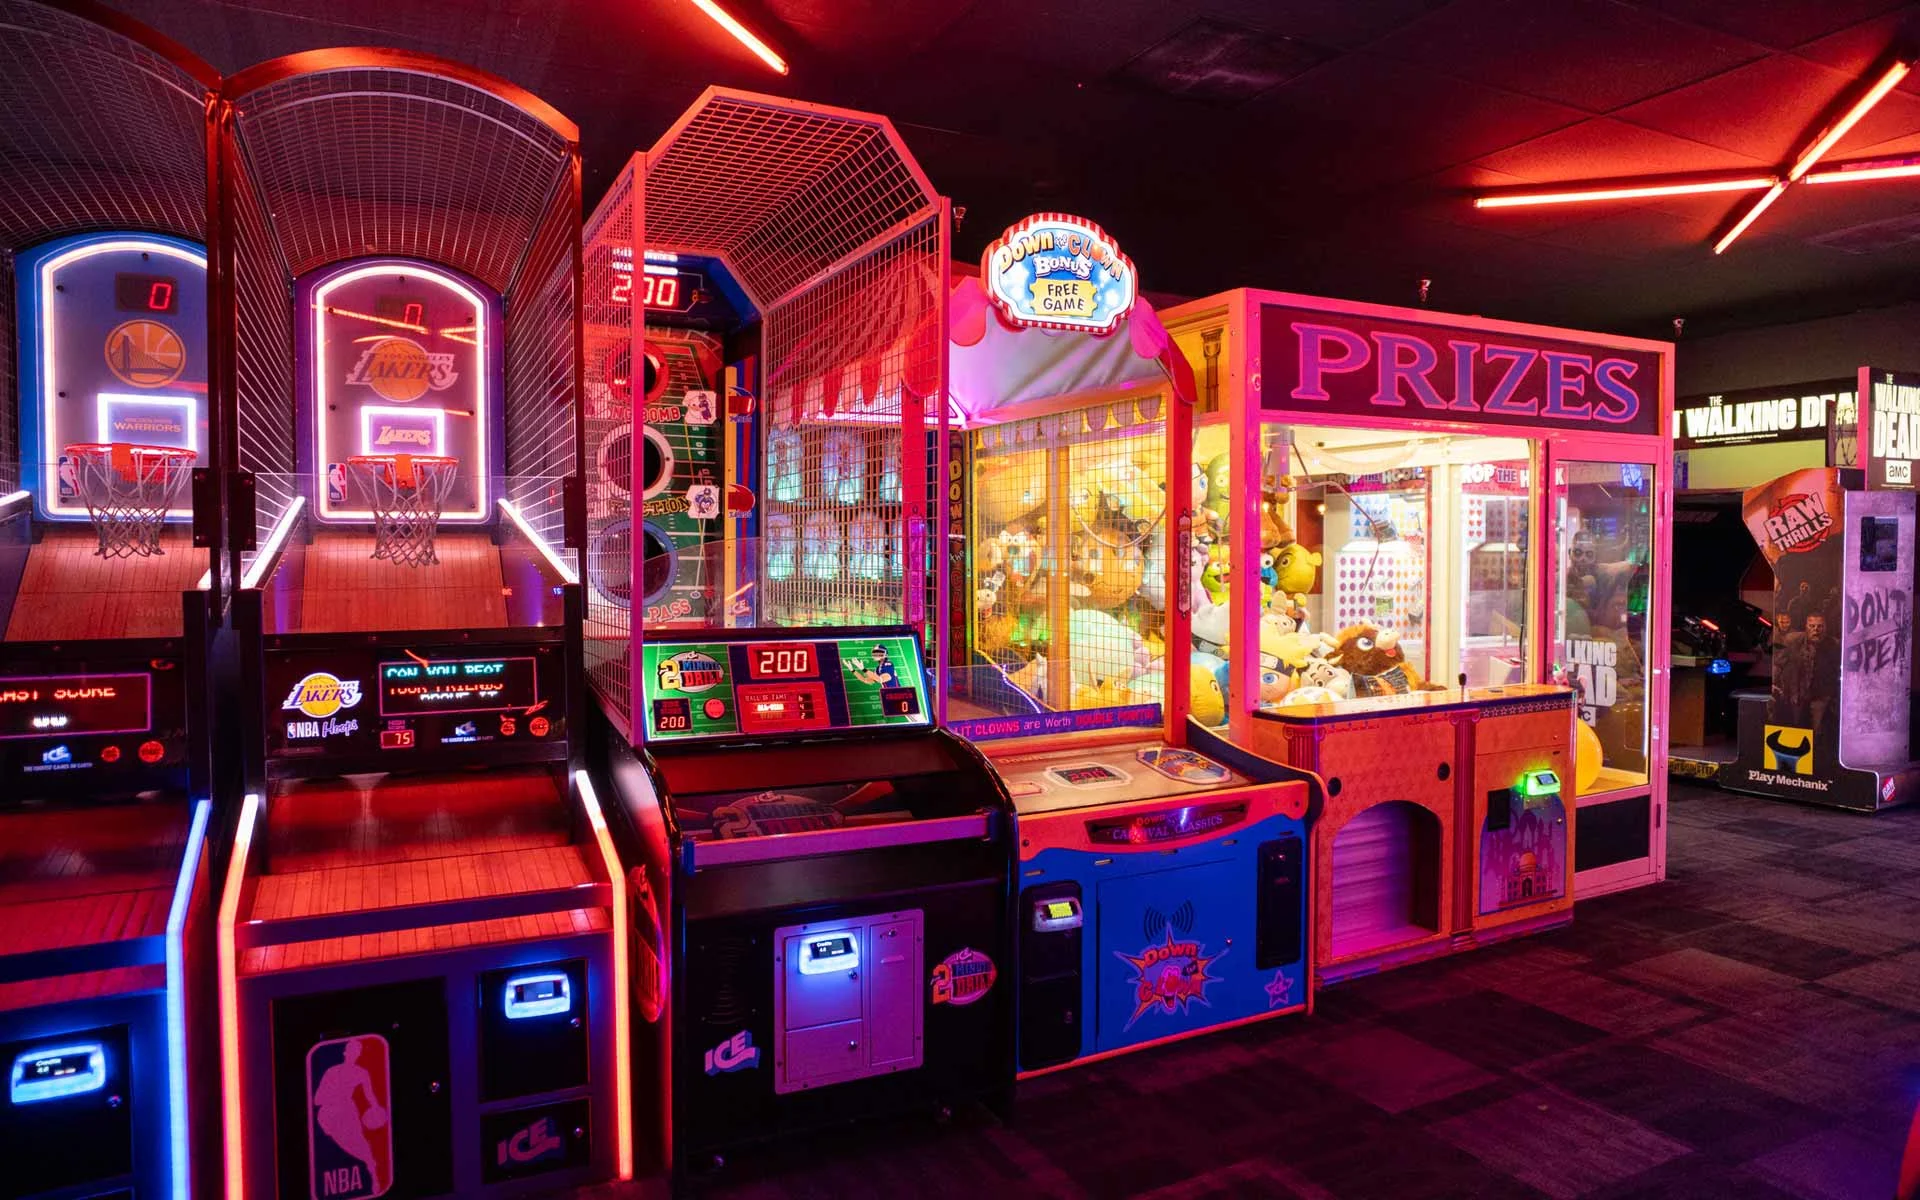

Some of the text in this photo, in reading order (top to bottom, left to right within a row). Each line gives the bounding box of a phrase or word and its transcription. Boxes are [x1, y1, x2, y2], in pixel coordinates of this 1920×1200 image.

[149, 282, 172, 310] 0
[1047, 283, 1079, 297] FREE
[1043, 297, 1085, 312] GAME
[1290, 322, 1640, 423] PRIZES
[1709, 396, 1723, 407] THE
[643, 406, 681, 422] BOMB
[1686, 398, 1797, 438] WALKING
[113, 422, 182, 433] WARRIORS
[1873, 410, 1920, 459] DEAD
[1497, 468, 1517, 483] THE
[1764, 492, 1825, 540] RAW
[1773, 513, 1833, 553] THRILLS
[648, 600, 692, 623] PASS
[760, 650, 807, 673] 200
[659, 660, 681, 690] 2
[288, 685, 357, 706] LAKERS
[901, 701, 909, 713] 0
[297, 717, 359, 738] NBA Hoops
[660, 716, 686, 729] 200
[975, 720, 1020, 736] CLOWNS
[1023, 721, 1041, 731] are
[1045, 716, 1072, 729] Worth
[1075, 711, 1113, 727] DOUBLE
[395, 733, 411, 745] 75
[42, 744, 71, 763] ICE
[1749, 769, 1828, 791] Play Mechanix
[932, 964, 950, 1004] 2
[704, 1030, 758, 1074] ICE
[497, 1118, 561, 1166] ICE
[323, 1165, 363, 1197] NBA
